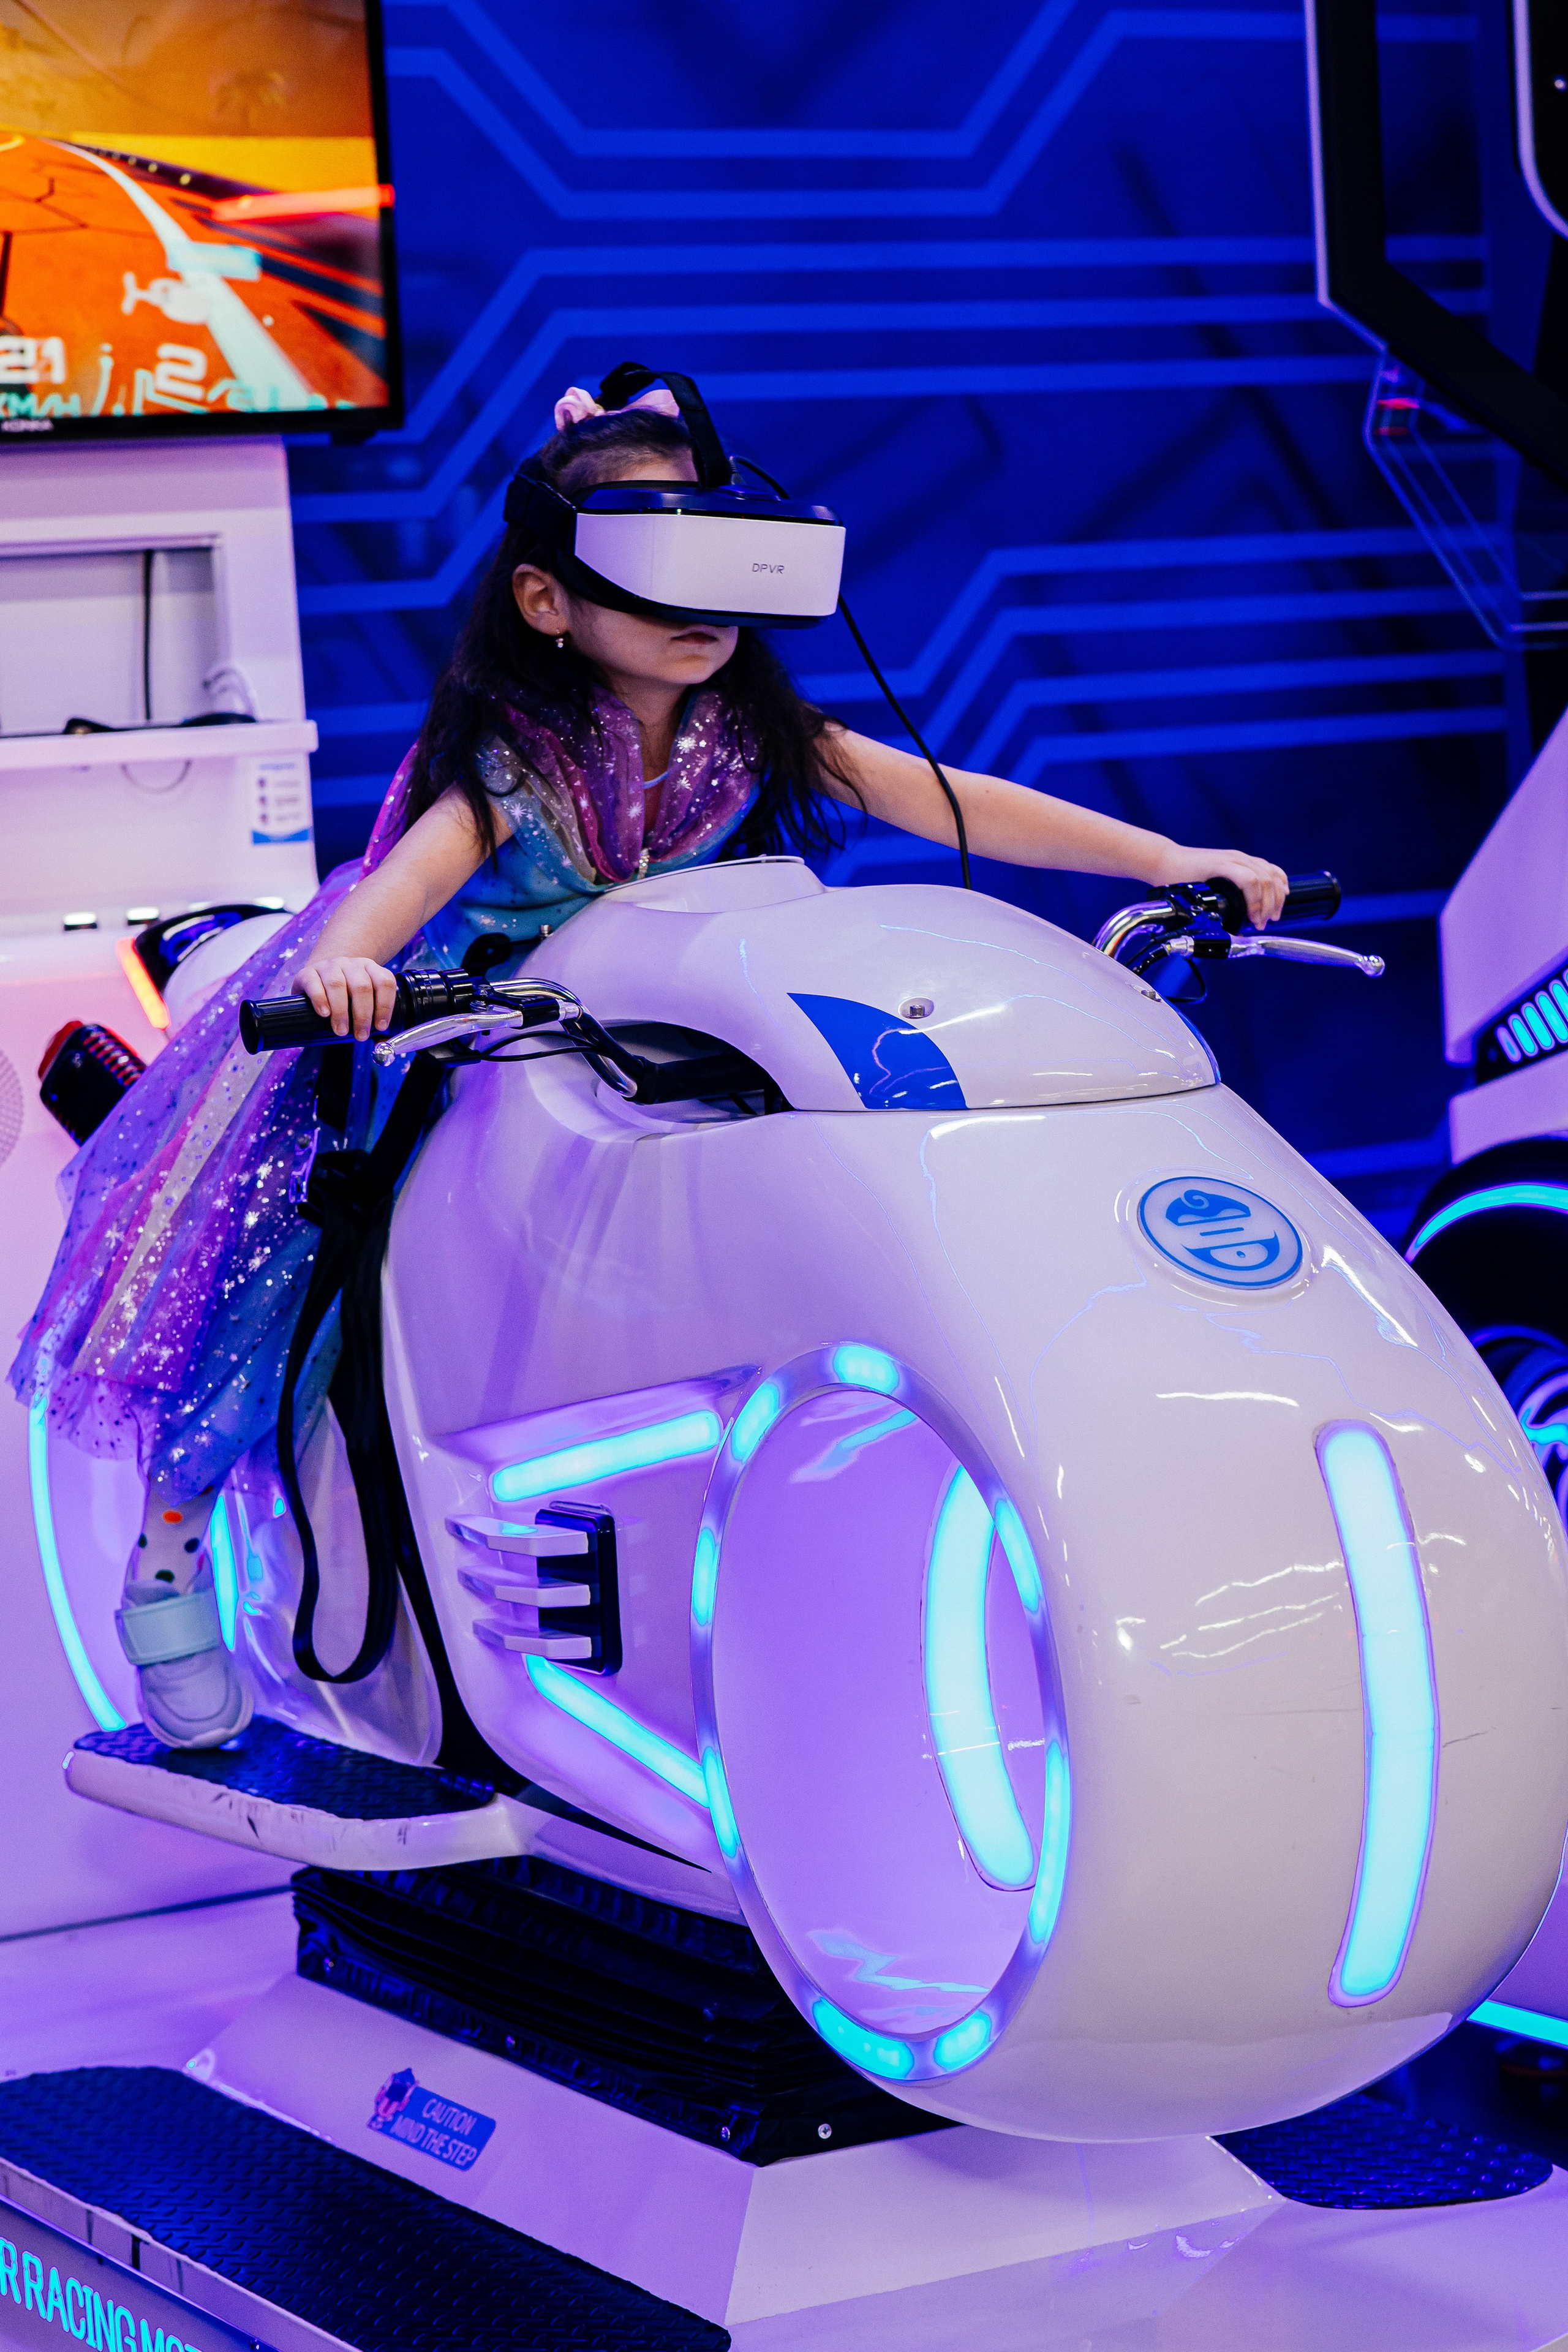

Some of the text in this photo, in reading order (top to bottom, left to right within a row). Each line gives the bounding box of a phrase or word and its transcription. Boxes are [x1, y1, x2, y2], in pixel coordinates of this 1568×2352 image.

[752, 563, 785, 574] DPVR
[422, 2098, 477, 2136] CAUTION
[389, 2115, 478, 2166] MIND THE STEP
[22, 2250, 136, 2352] RACING
